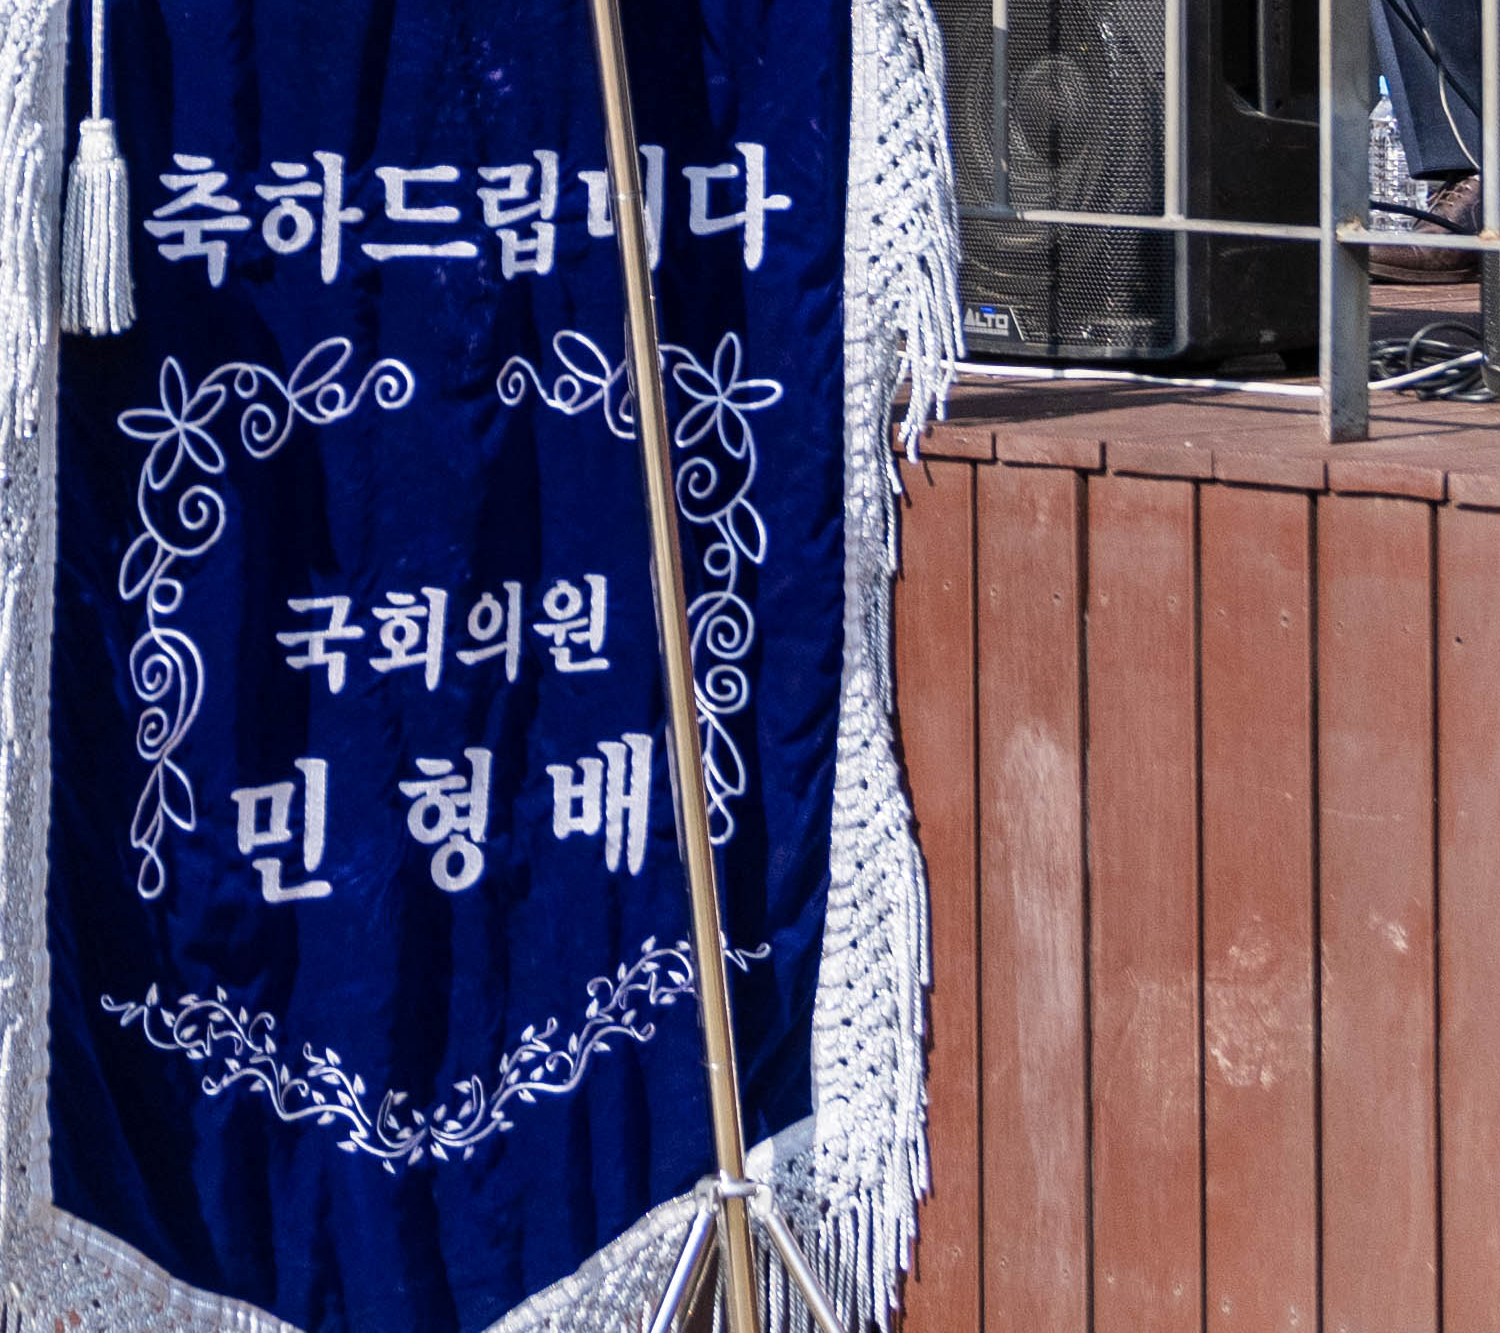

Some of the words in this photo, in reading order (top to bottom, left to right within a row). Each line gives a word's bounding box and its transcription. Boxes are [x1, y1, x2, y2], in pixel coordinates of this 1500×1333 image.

[142, 140, 792, 287] 축하드립니다
[963, 307, 1009, 329] ALTO
[275, 574, 611, 693] 국회의원
